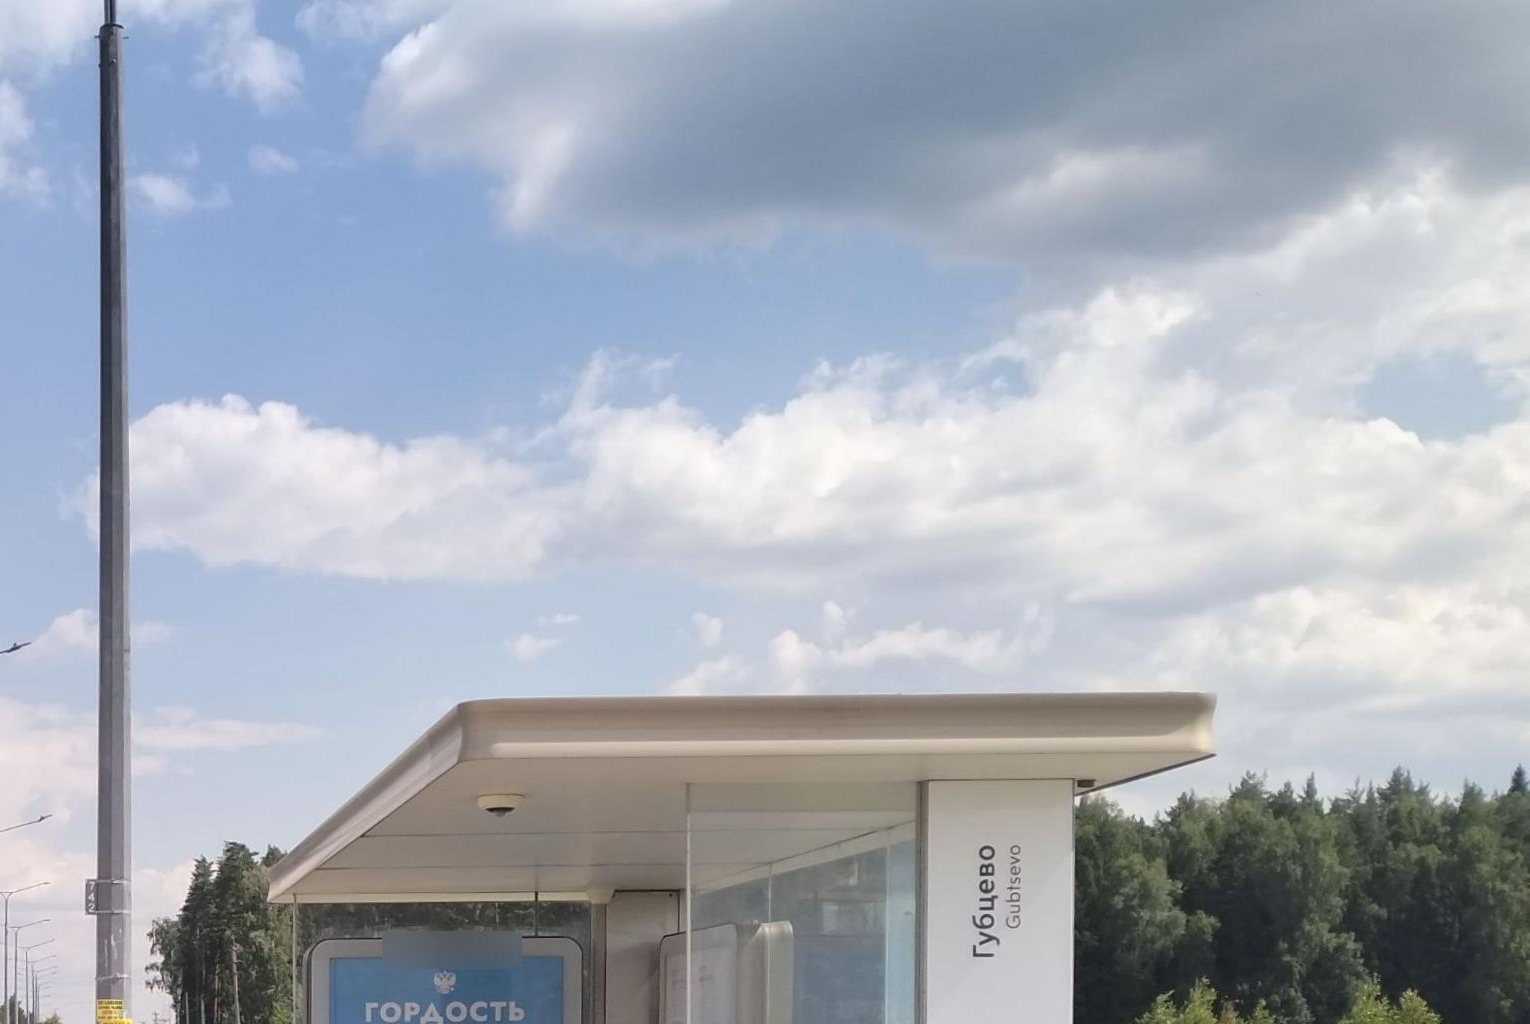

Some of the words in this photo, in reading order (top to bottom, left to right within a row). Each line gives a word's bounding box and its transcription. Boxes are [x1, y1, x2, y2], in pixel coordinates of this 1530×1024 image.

[972, 845, 1000, 957] Губцево
[1006, 844, 1021, 929] Gubtsevo
[365, 1001, 525, 1024] ГОРДОСТЬ
